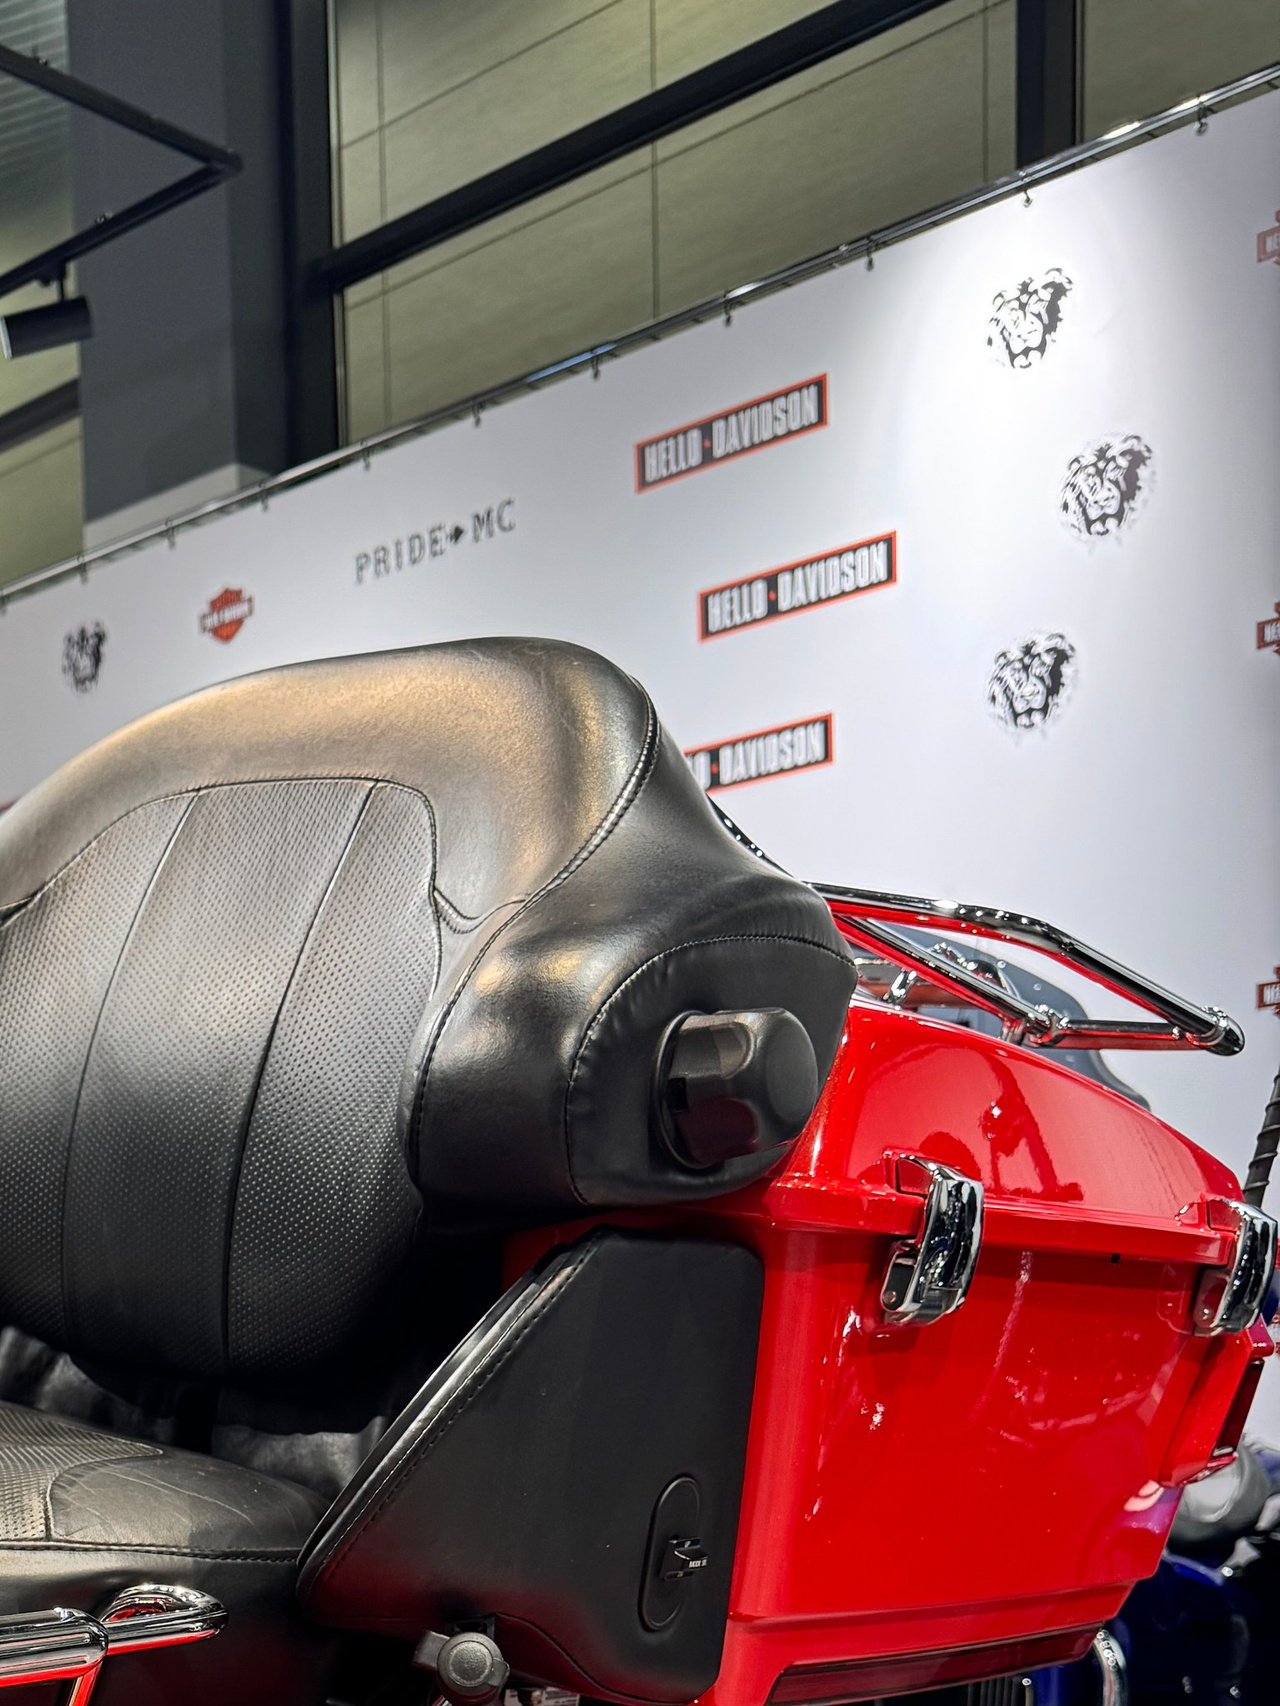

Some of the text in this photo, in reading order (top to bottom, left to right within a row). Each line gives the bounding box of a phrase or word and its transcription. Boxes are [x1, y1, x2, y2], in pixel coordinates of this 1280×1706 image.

[644, 384, 819, 484] HELLO DAVIDSON
[354, 498, 516, 585] PRIDE MC
[707, 540, 888, 633] HELLO DAVIDSON
[719, 719, 826, 786] DAVIDSON
